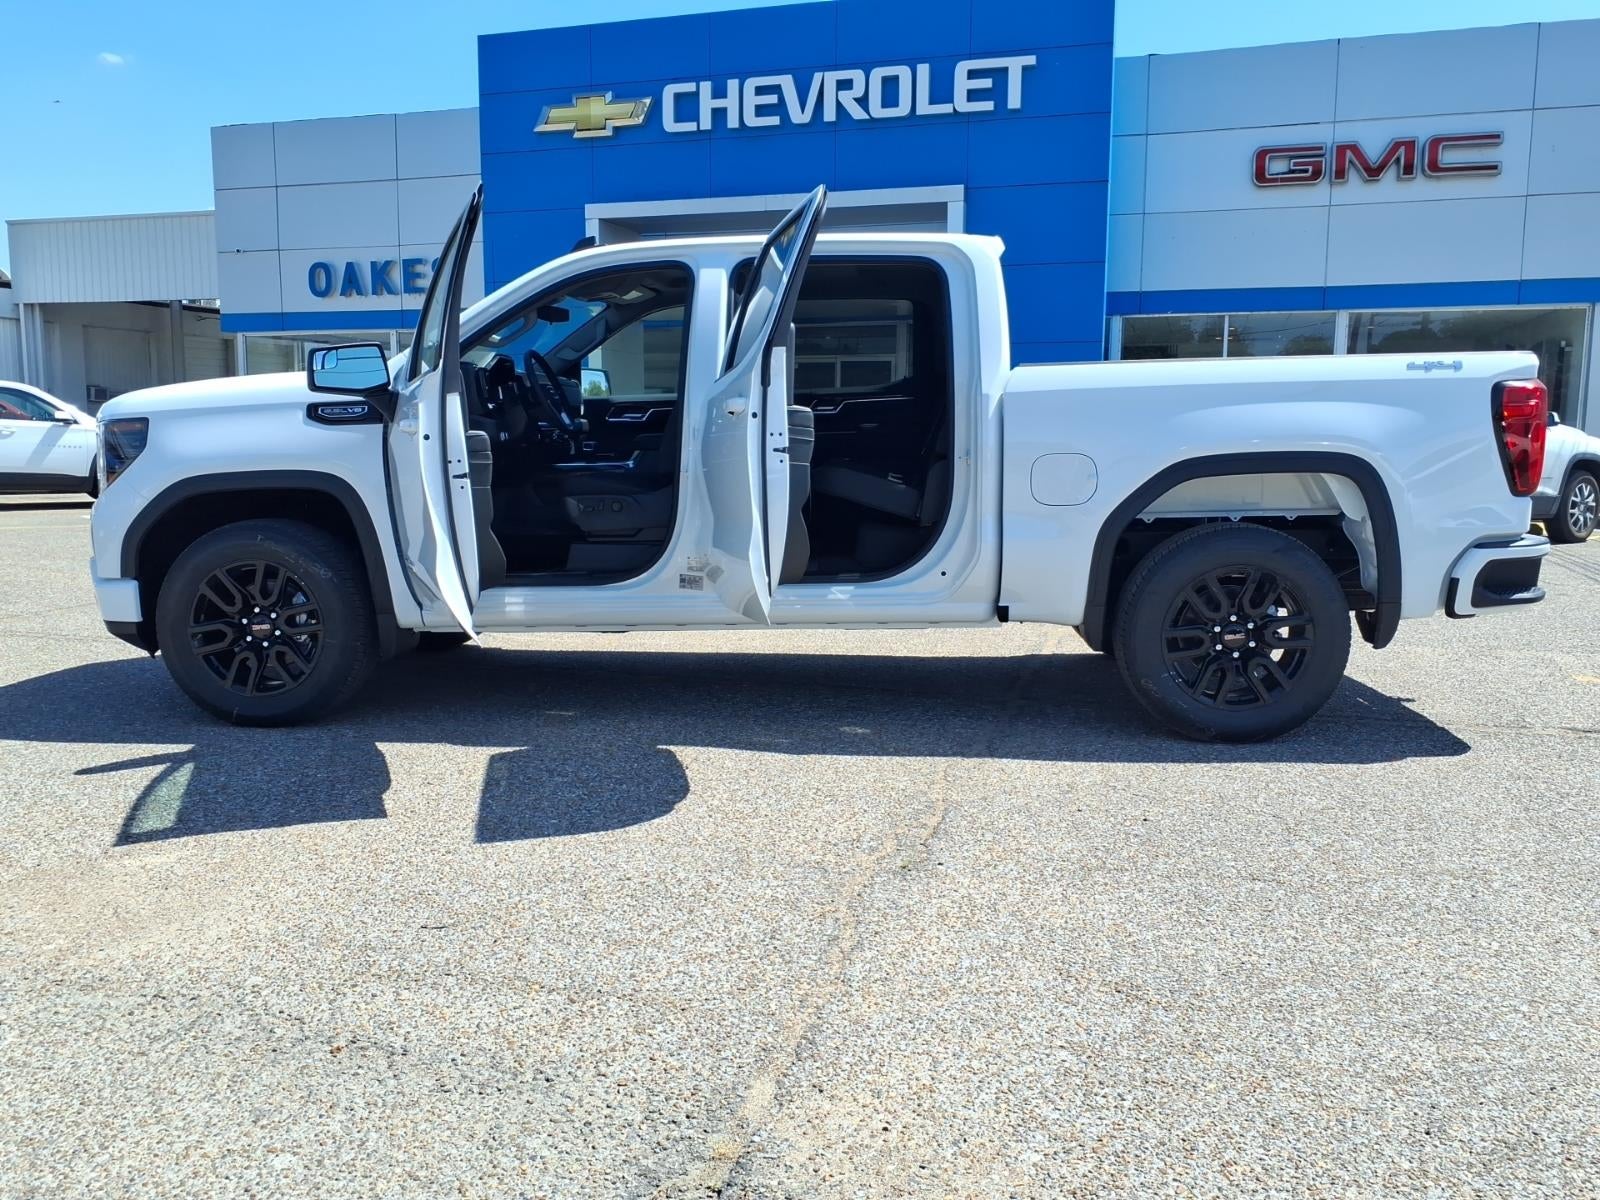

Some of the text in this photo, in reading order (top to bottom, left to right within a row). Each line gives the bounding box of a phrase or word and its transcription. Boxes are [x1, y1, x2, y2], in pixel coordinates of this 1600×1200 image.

[662, 54, 1037, 133] CHEVROLET
[1252, 131, 1504, 187] GMC
[308, 256, 440, 298] OAKE
